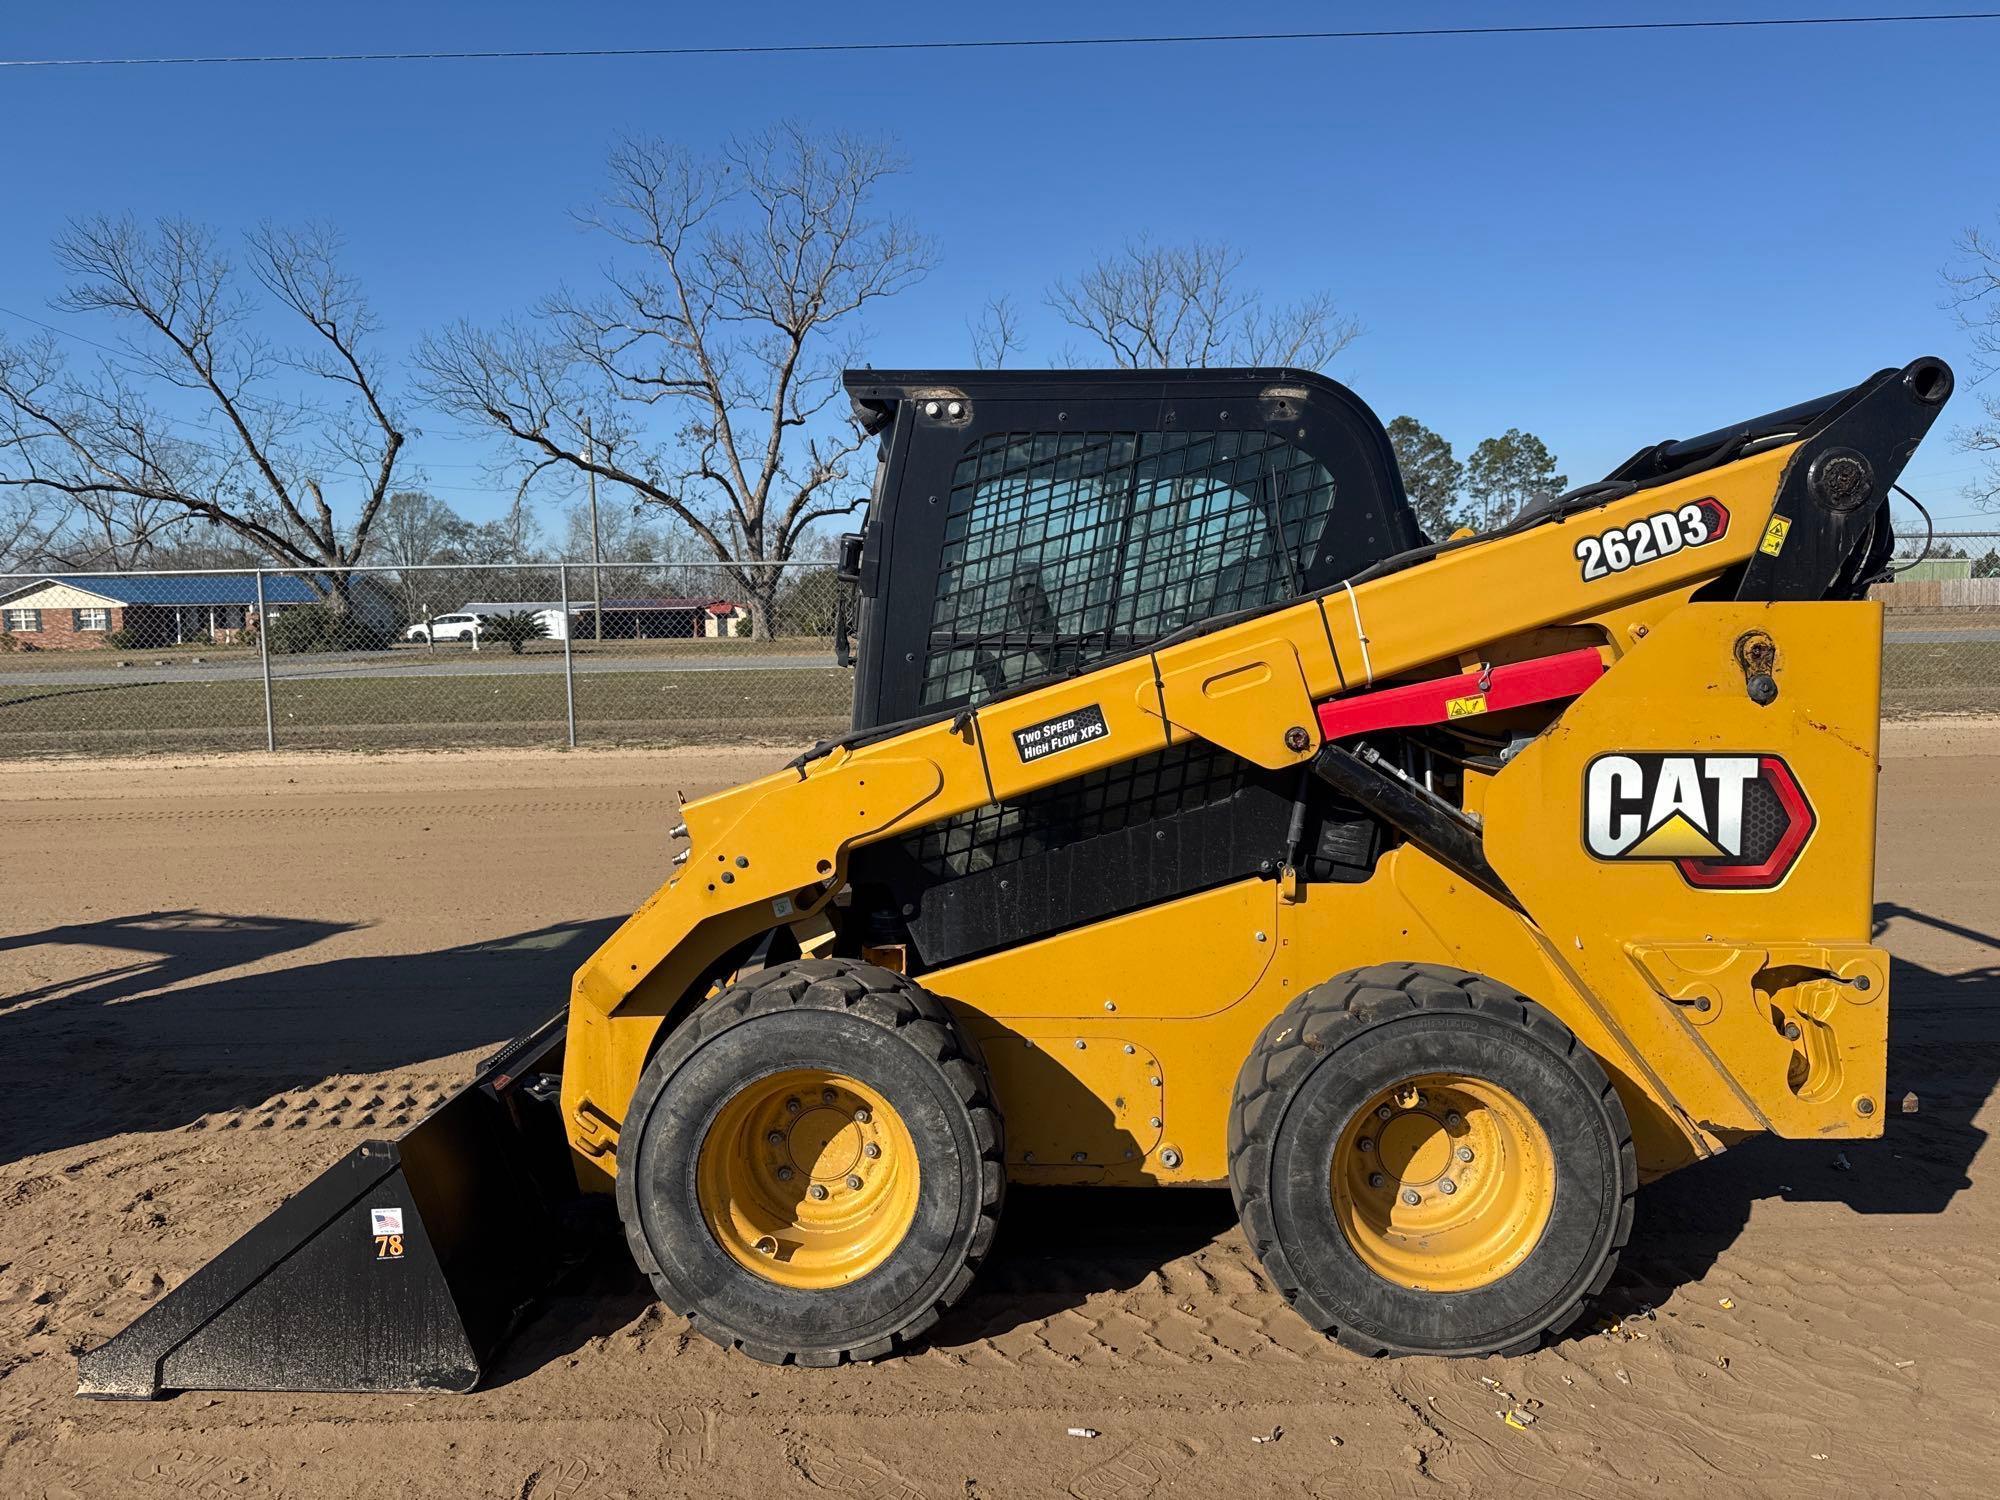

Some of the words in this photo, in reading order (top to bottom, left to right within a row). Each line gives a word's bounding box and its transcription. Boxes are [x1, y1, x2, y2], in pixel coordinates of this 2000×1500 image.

[1577, 505, 1708, 580] 262D3
[1080, 722, 1103, 740] XPS
[1588, 756, 1759, 856] CAT
[375, 1235, 404, 1257] 78
[1284, 1243, 1383, 1337] GALAXY
